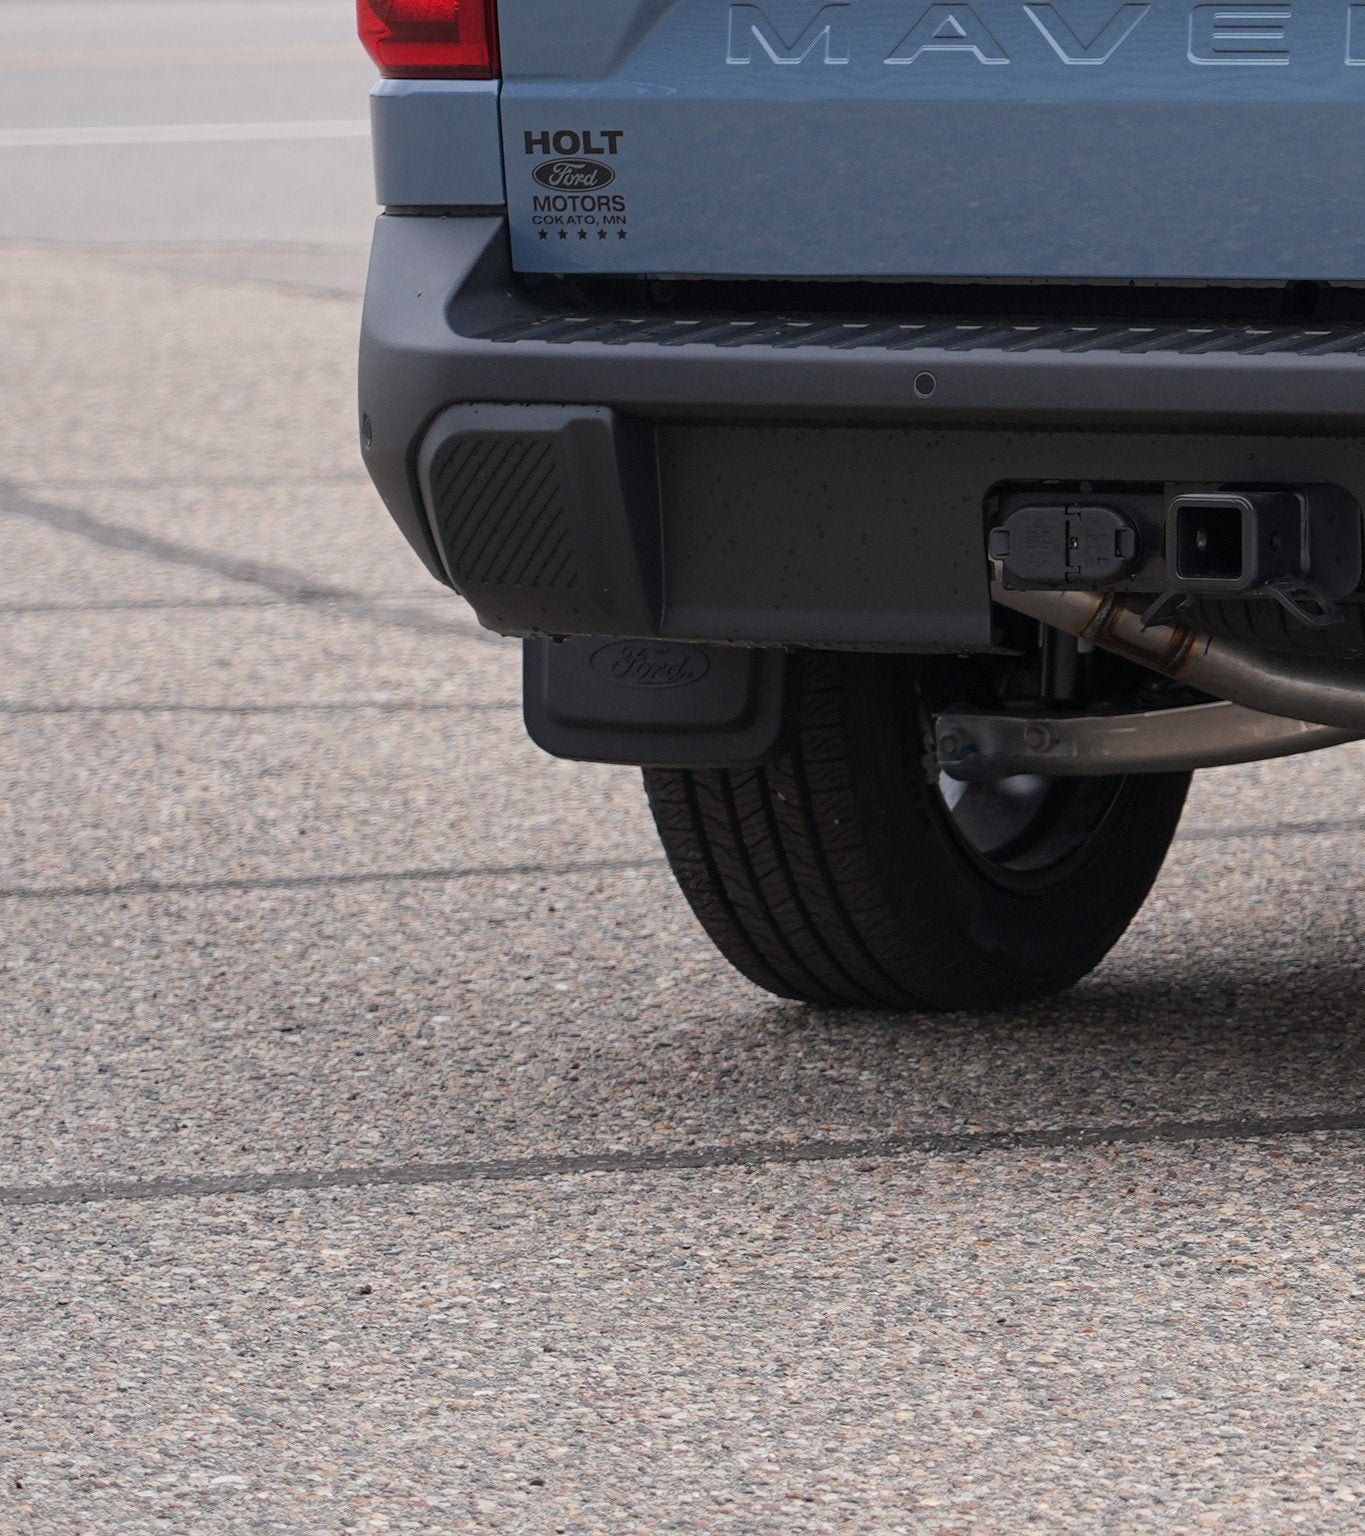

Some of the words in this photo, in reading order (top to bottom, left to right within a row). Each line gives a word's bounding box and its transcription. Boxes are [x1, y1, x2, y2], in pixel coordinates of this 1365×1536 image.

[524, 130, 624, 155] HOLT
[548, 162, 599, 186] Ford
[533, 195, 626, 212] MOTORS
[532, 215, 600, 226] COKATO,
[602, 215, 627, 225] MN
